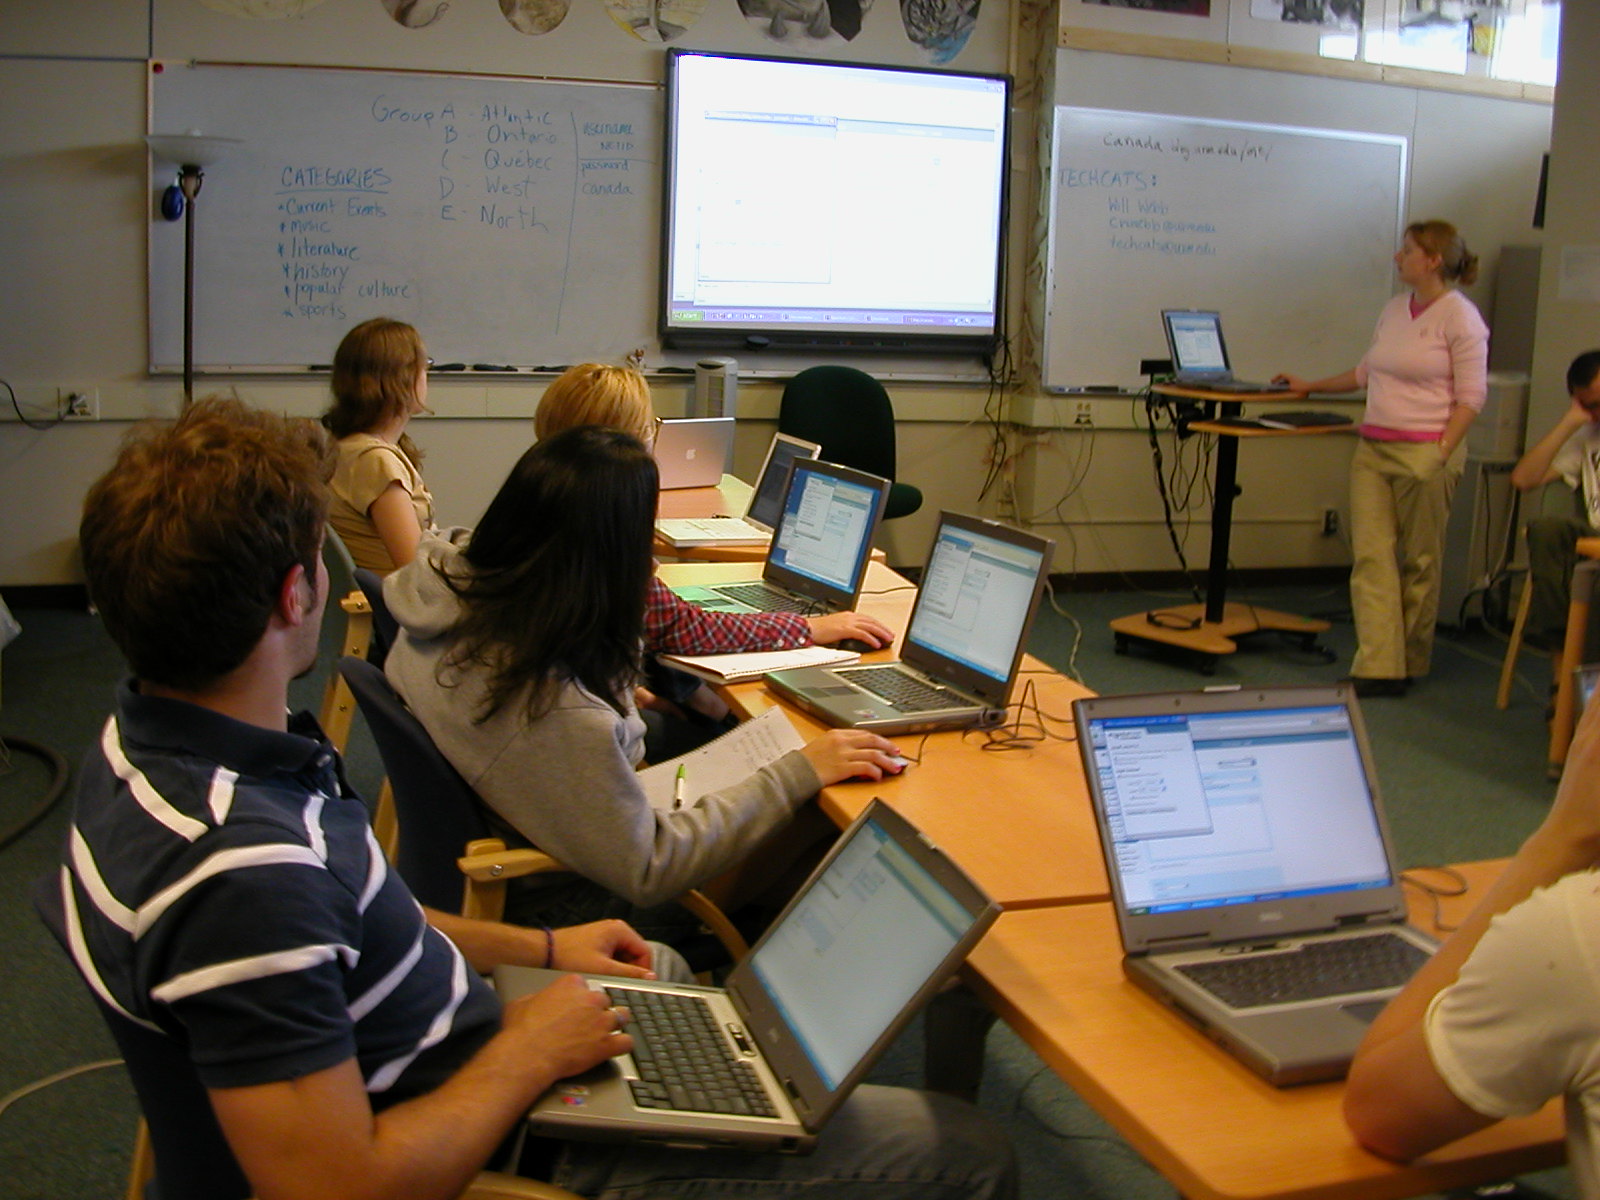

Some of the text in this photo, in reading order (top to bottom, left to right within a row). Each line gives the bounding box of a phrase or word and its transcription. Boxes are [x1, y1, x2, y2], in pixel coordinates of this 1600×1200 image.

[371, 94, 434, 129] Group
[441, 102, 455, 119] A
[481, 104, 553, 126] Atlantic
[444, 125, 458, 144] B
[487, 123, 557, 145] Ontario
[281, 166, 393, 189] CATEGORIES
[439, 176, 455, 200] D
[485, 175, 537, 199] West
[285, 197, 336, 216] Current
[441, 204, 457, 221] E
[480, 203, 550, 232] North
[357, 280, 411, 299] culture
